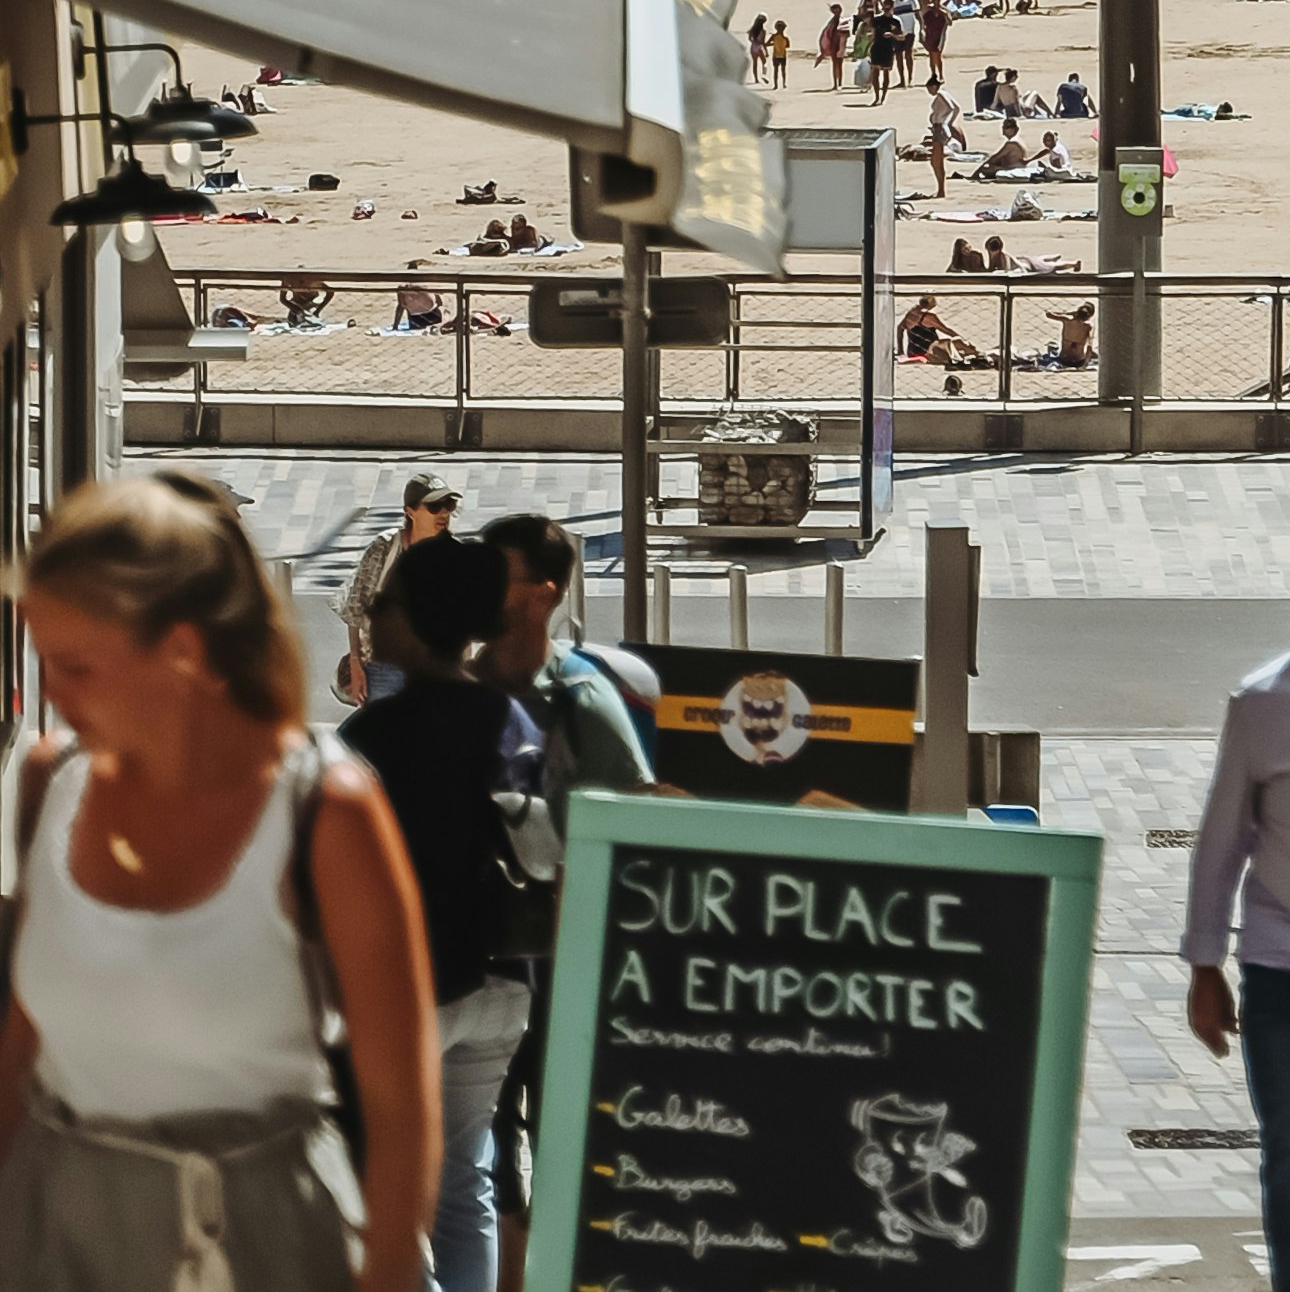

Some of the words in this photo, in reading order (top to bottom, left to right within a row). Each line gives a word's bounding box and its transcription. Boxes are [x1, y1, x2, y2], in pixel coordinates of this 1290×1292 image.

[618, 860, 736, 936] SUR
[764, 872, 983, 954] PLACE
[610, 949, 651, 1003] A
[685, 956, 985, 1031] EMPORTER
[609, 1016, 733, 1053] Service
[617, 1086, 750, 1137] Galettes
[616, 1154, 737, 1201] Burgers
